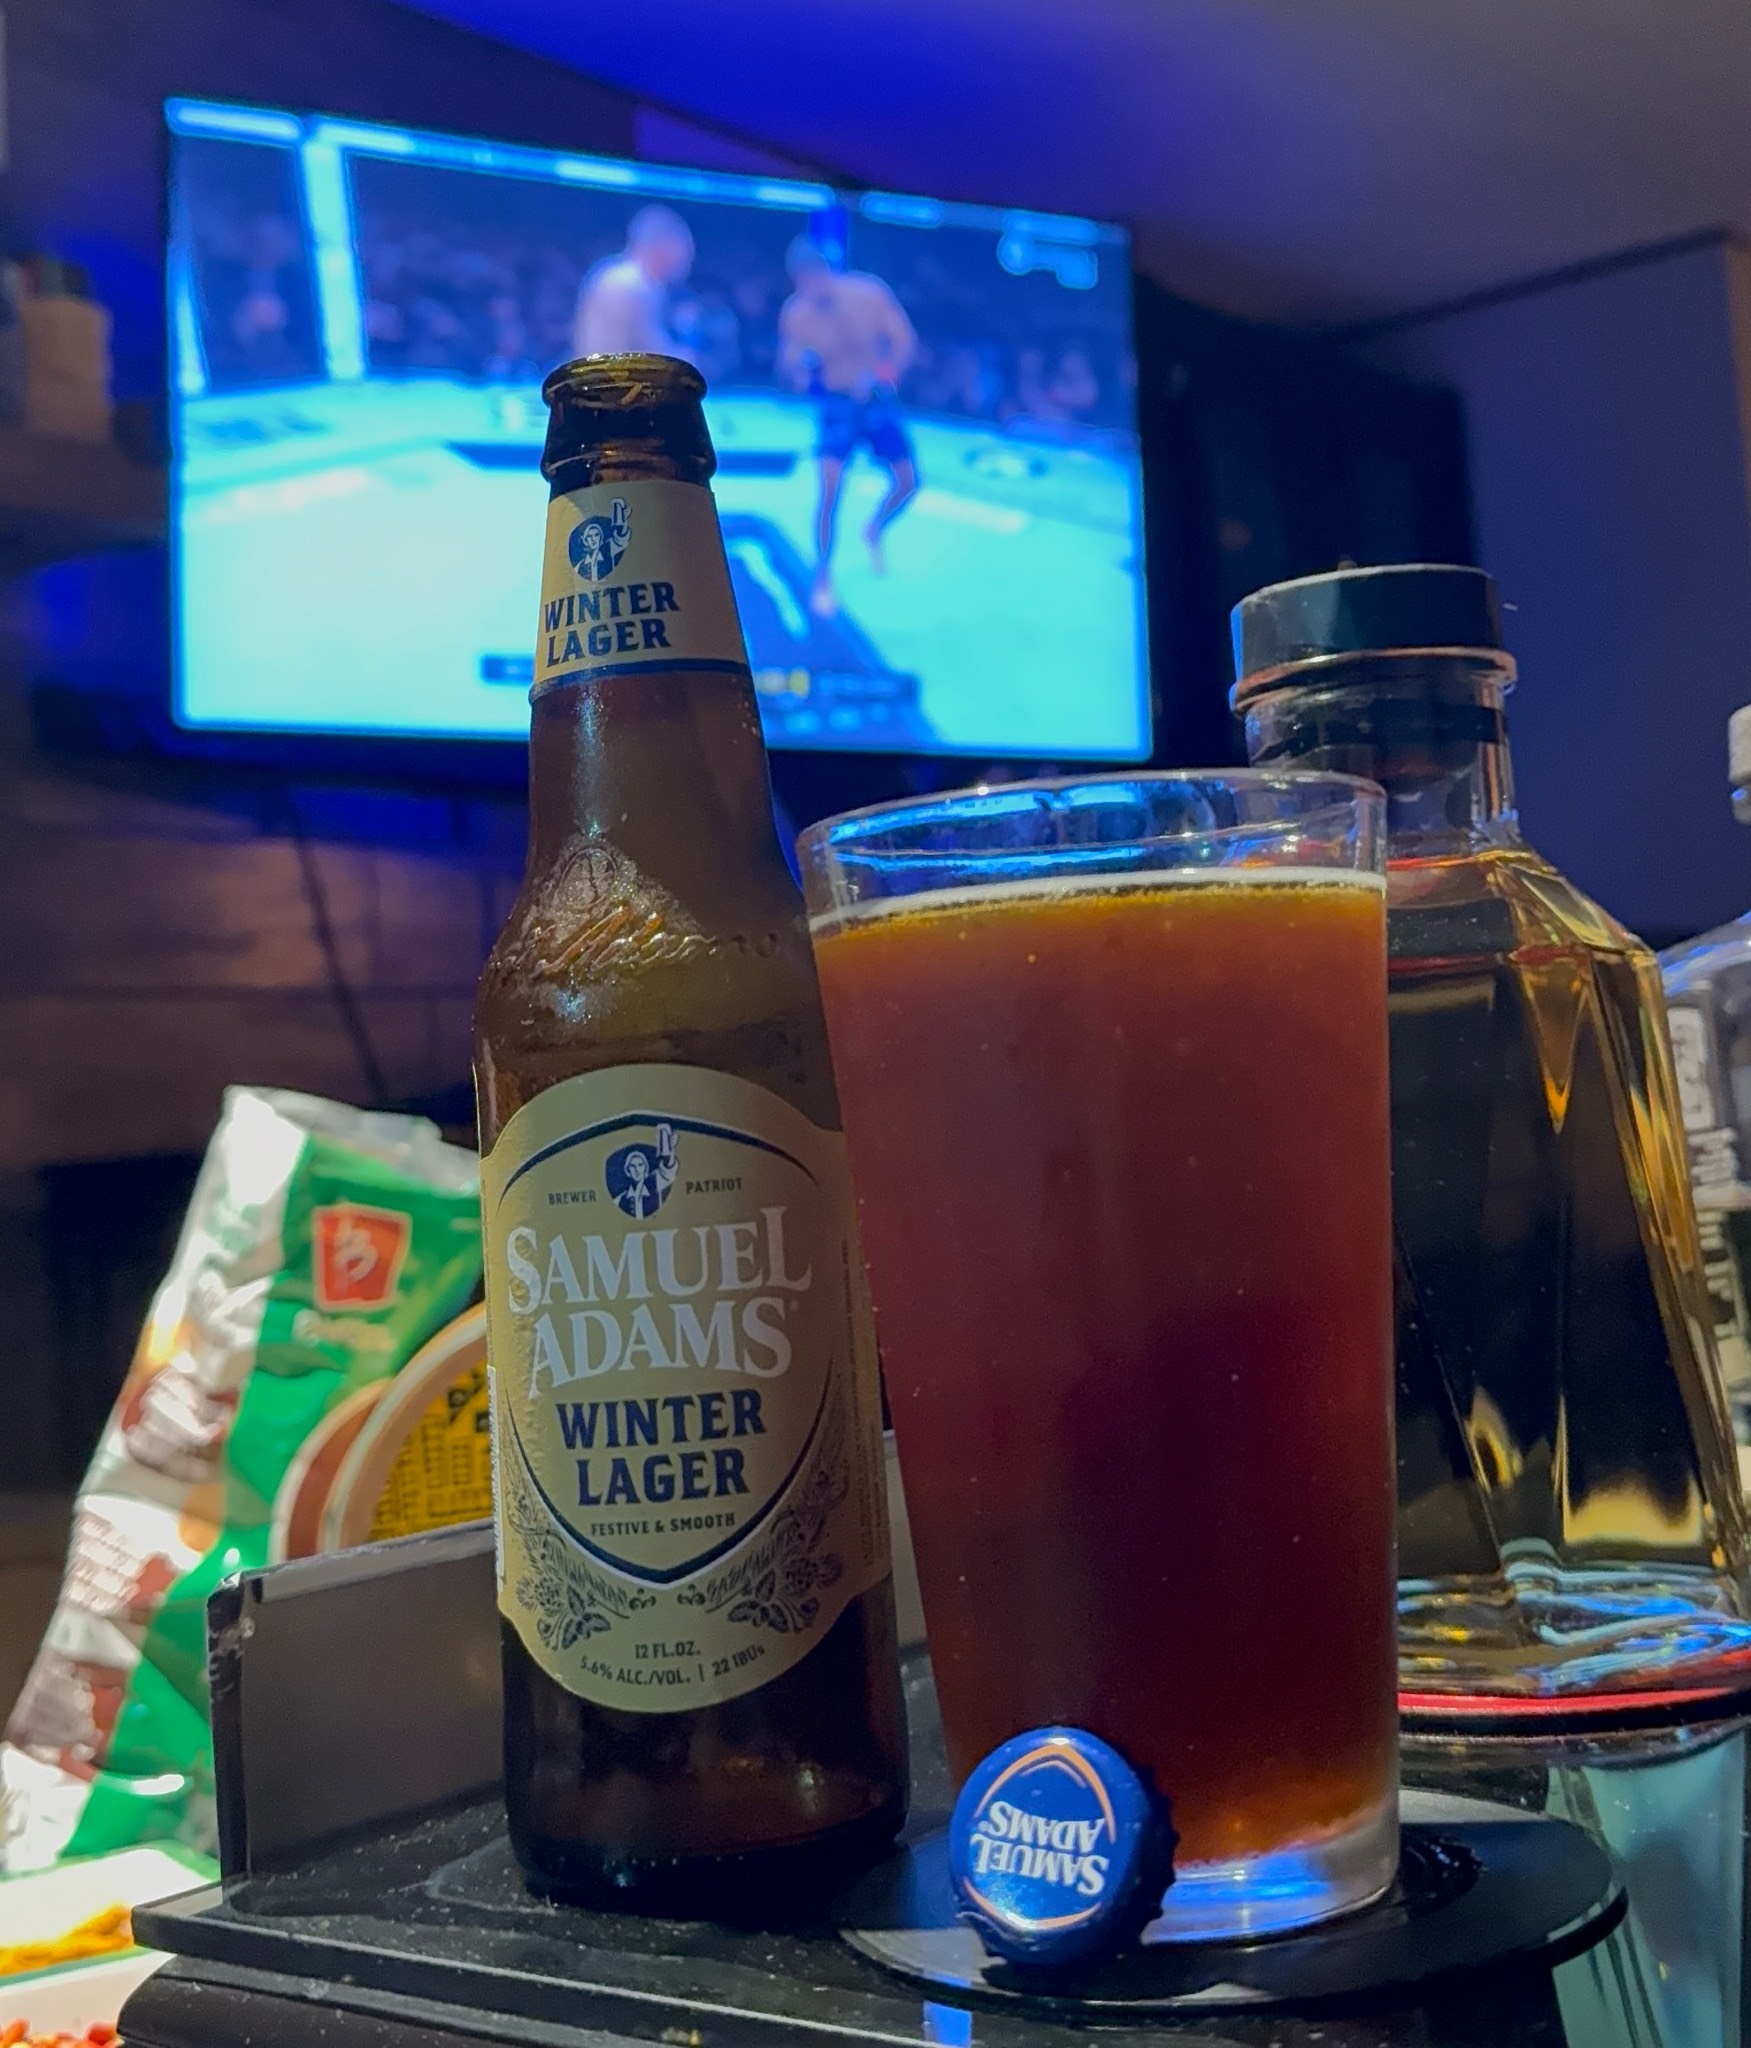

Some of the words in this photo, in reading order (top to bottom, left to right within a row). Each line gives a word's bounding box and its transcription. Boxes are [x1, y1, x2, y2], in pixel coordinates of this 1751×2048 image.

[544, 581, 681, 633] WINTER
[546, 618, 673, 668] LAGER
[548, 1189, 597, 1206] BREWER
[685, 1177, 743, 1195] PATRIOT
[506, 1206, 813, 1315] SAMUEL
[528, 1297, 793, 1400] ADAMS
[556, 1388, 767, 1450] WINTER
[576, 1447, 751, 1506] LAGER
[591, 1518, 650, 1537] FESTIVE
[654, 1517, 665, 1534] &
[670, 1512, 736, 1532] SMOOTH
[580, 1655, 613, 1680] 5.6%
[616, 1667, 691, 1686] ALC./VOL.
[635, 1643, 648, 1659] 12
[712, 1660, 731, 1677] 22
[734, 1642, 766, 1668] IBUs
[988, 1800, 1106, 1853] ADAMS
[969, 1833, 1110, 1895] SAMUEL
